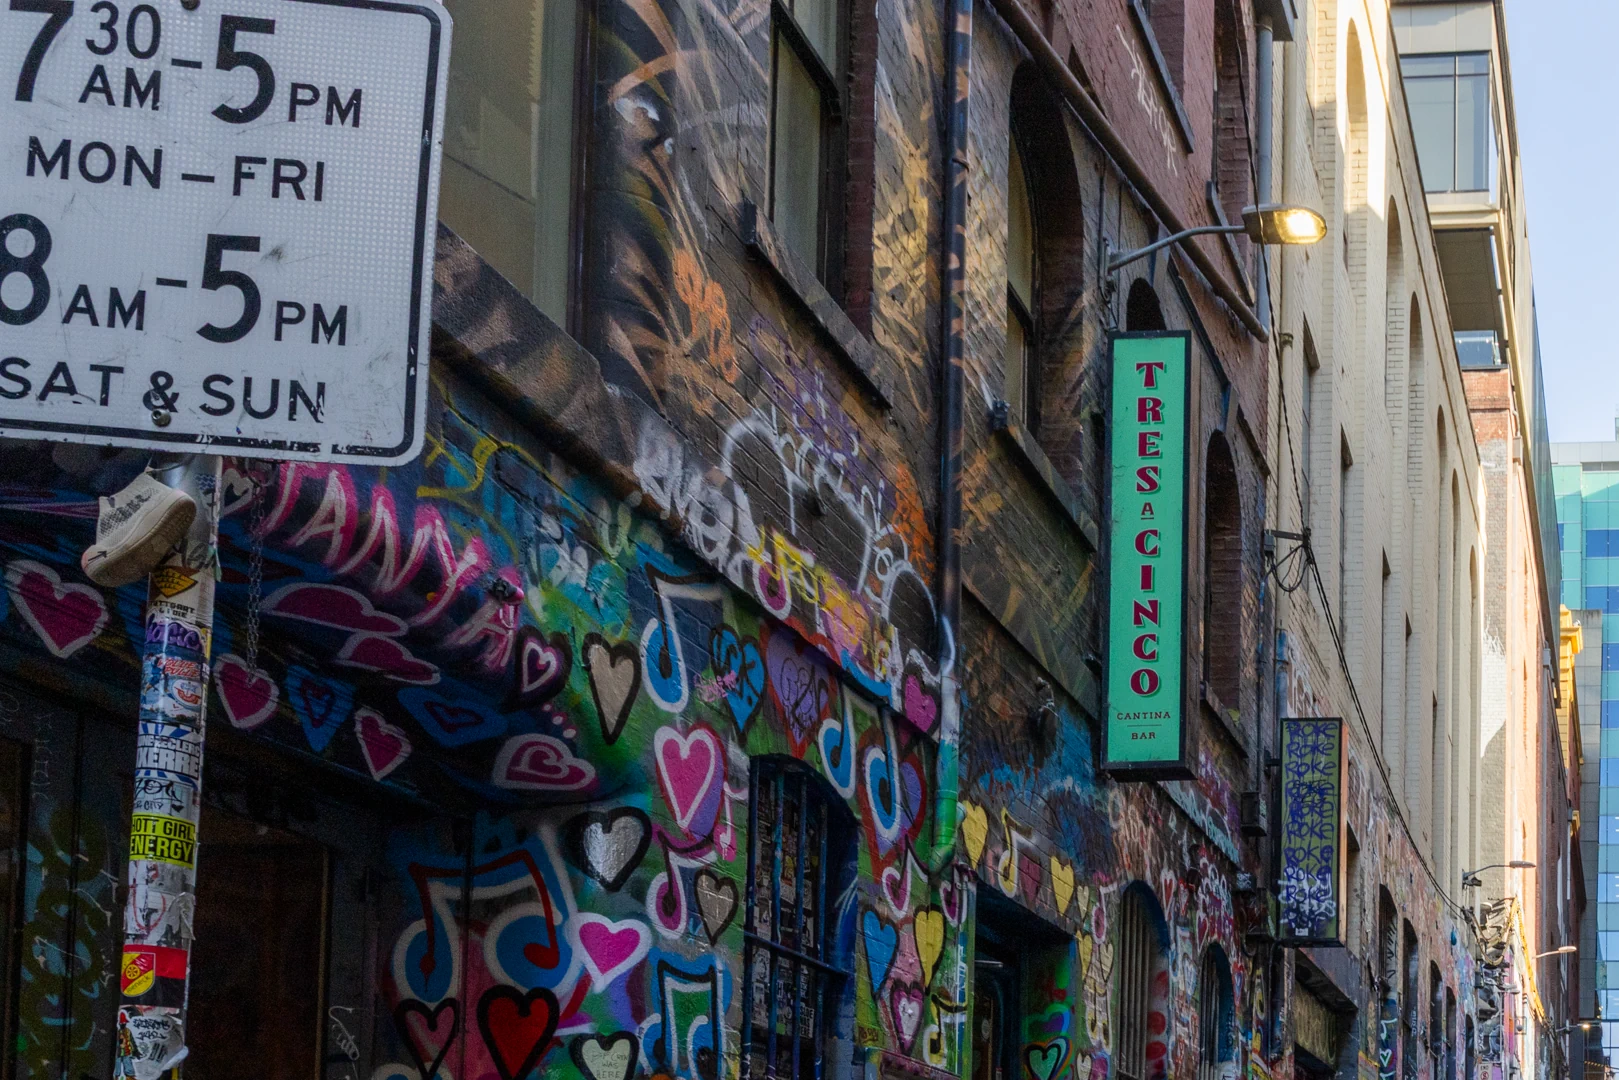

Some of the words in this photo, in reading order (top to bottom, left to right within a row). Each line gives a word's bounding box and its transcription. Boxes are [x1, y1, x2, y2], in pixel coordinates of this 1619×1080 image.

[8, 1, 75, 102] 7
[85, 0, 161, 60] 30
[78, 64, 161, 111] AM
[211, 14, 276, 125] 5
[288, 82, 362, 128] PM
[0, 213, 52, 326] 8
[62, 284, 146, 331] AM
[195, 233, 261, 343] 5
[274, 300, 348, 346] PM
[0, 357, 124, 407] SAT
[142, 370, 179, 414] &
[199, 374, 326, 424] SUN
[1135, 361, 1167, 495] TRES
[1130, 528, 1163, 697] CINCO
[1116, 711, 1171, 721] CANTINA
[1131, 732, 1156, 741] BAR
[130, 836, 194, 863] ENERGY
[163, 821, 194, 840] GIRL
